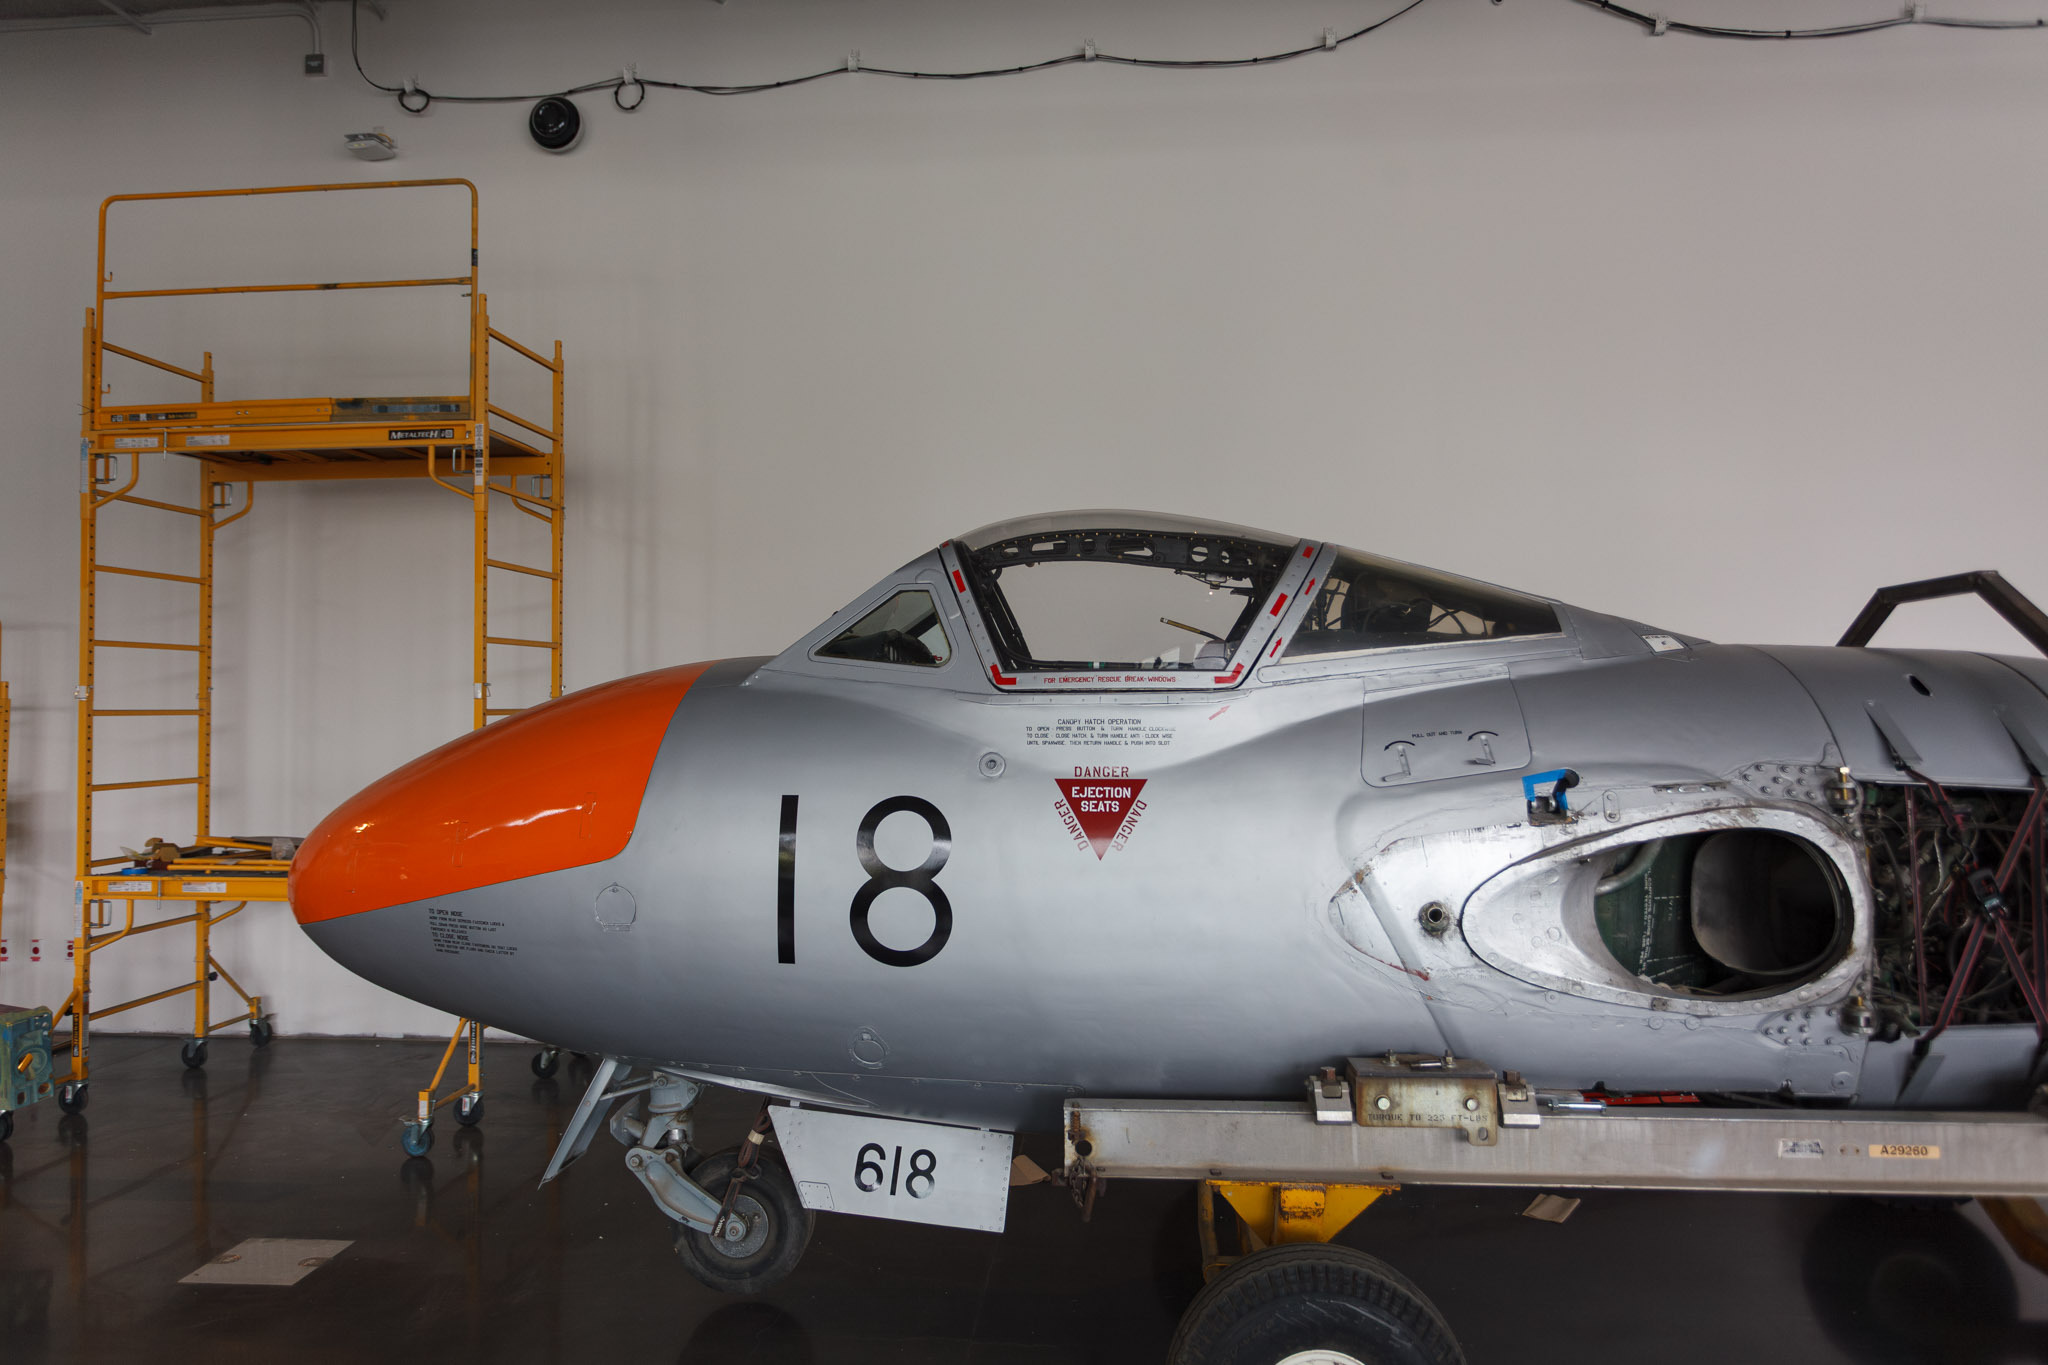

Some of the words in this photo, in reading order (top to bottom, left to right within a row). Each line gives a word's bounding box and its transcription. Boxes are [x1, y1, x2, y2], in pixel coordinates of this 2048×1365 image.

[390, 430, 438, 440] METALTECH
[1074, 766, 1129, 778] DANGER
[1072, 786, 1131, 798] EJECTION
[1080, 800, 1120, 812] SEATS
[1054, 798, 1090, 852] DANGER
[1111, 800, 1148, 852] DANGER
[778, 794, 953, 968] 18
[1880, 1145, 1928, 1156] A29260
[854, 1142, 936, 1200] 618
